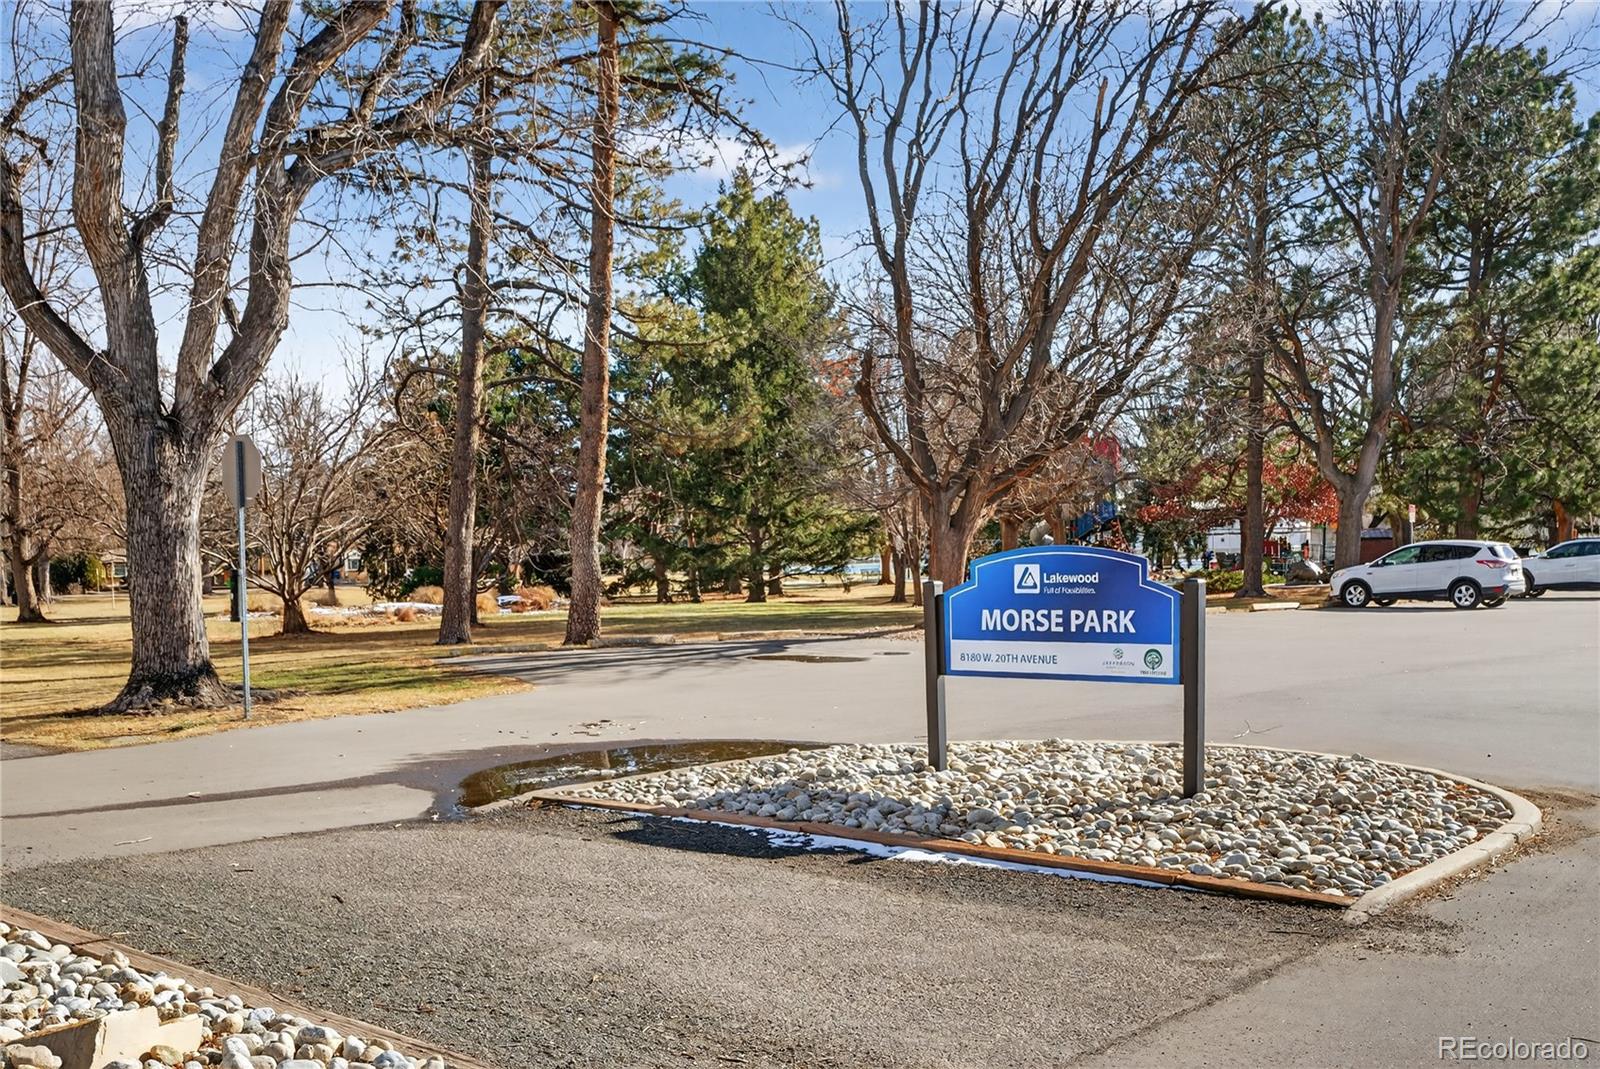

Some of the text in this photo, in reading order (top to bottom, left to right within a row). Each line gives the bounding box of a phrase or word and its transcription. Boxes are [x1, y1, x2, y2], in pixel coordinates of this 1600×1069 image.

[1043, 572, 1099, 584] Lakewood
[1043, 586, 1054, 594] Full
[981, 609, 1136, 634] MORSE PARK
[960, 652, 1058, 665] 8180 W. 20TH AVENUE
